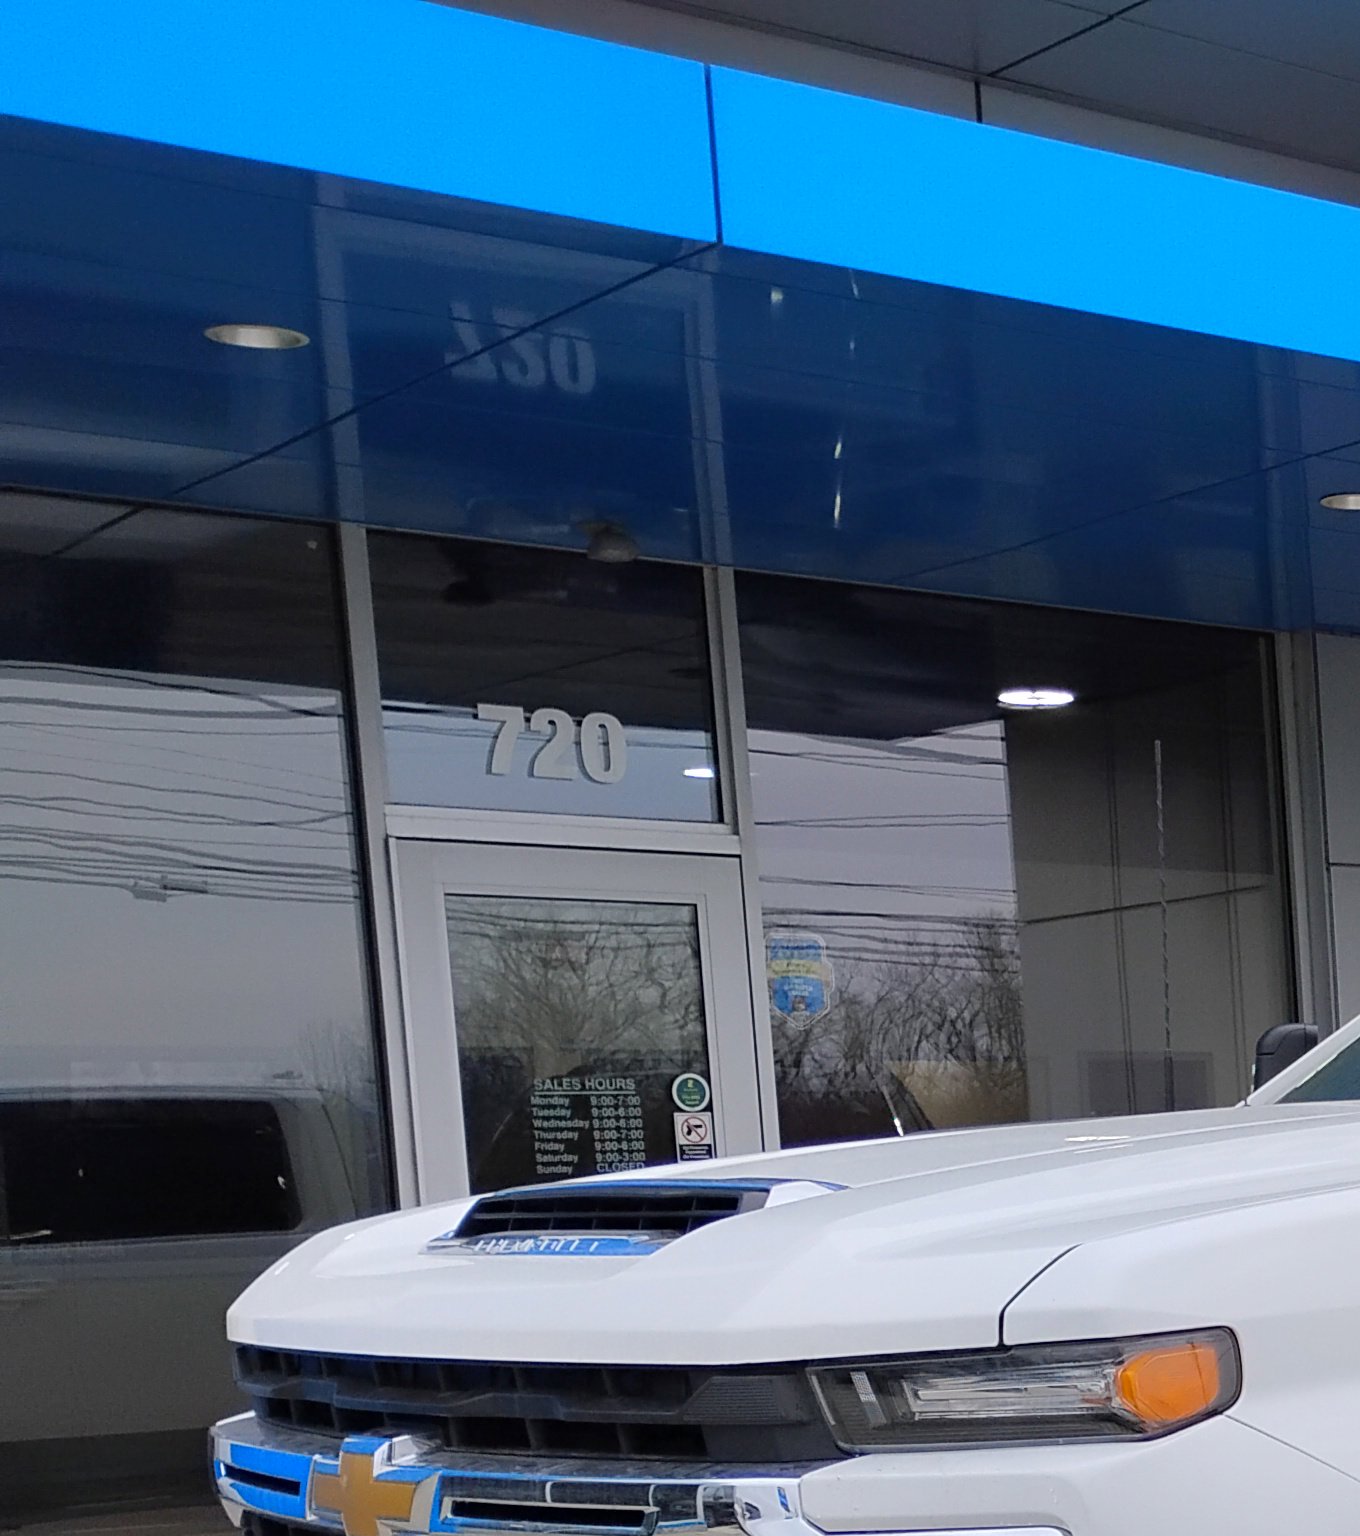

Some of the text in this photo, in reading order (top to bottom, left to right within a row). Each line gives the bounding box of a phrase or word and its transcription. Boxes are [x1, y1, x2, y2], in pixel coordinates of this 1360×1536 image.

[477, 703, 628, 784] 720
[534, 1078, 636, 1090] SALES HOURS
[531, 1096, 570, 1107] Monday
[532, 1107, 572, 1118] Tuesday
[532, 1119, 590, 1130] Wednesday
[534, 1130, 579, 1141] Thursday
[534, 1141, 565, 1152] Friday
[535, 1153, 579, 1164] Saturday
[536, 1163, 645, 1175] Sunday CLOSED
